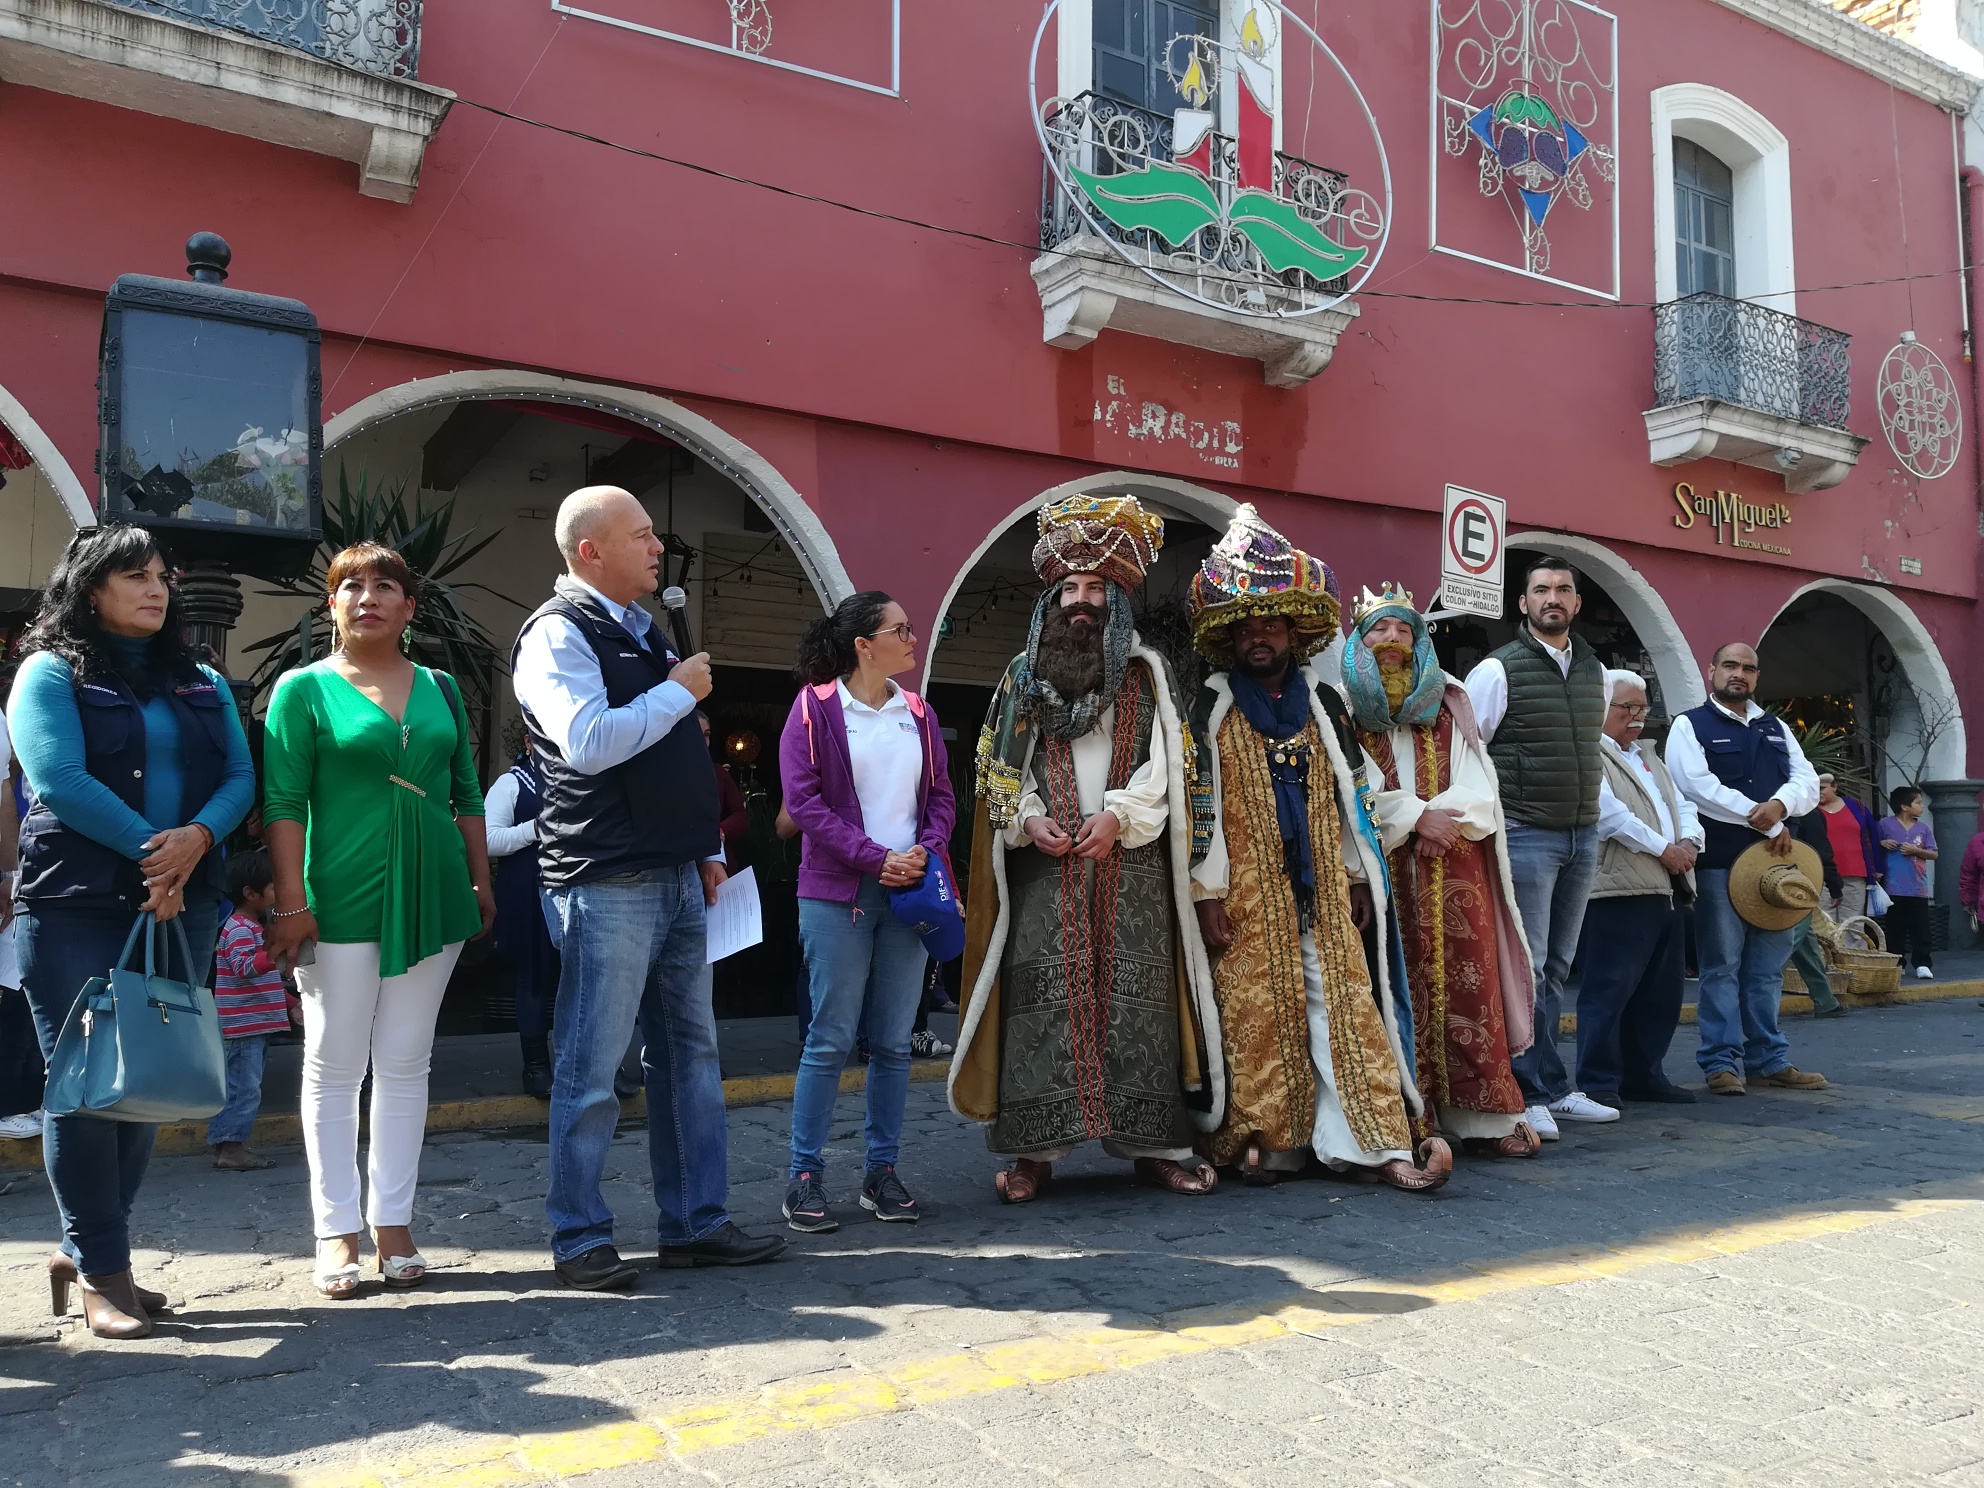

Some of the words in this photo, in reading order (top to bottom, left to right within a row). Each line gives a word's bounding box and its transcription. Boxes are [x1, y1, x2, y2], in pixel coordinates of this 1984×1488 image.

[1462, 510, 1486, 562] E
[1739, 539, 1761, 551] COCINA
[1762, 541, 1792, 556] MEXICANA
[1445, 595, 1467, 608] COLON
[1447, 584, 1481, 600] EXCLUSIVO
[1482, 593, 1499, 603] SITIO
